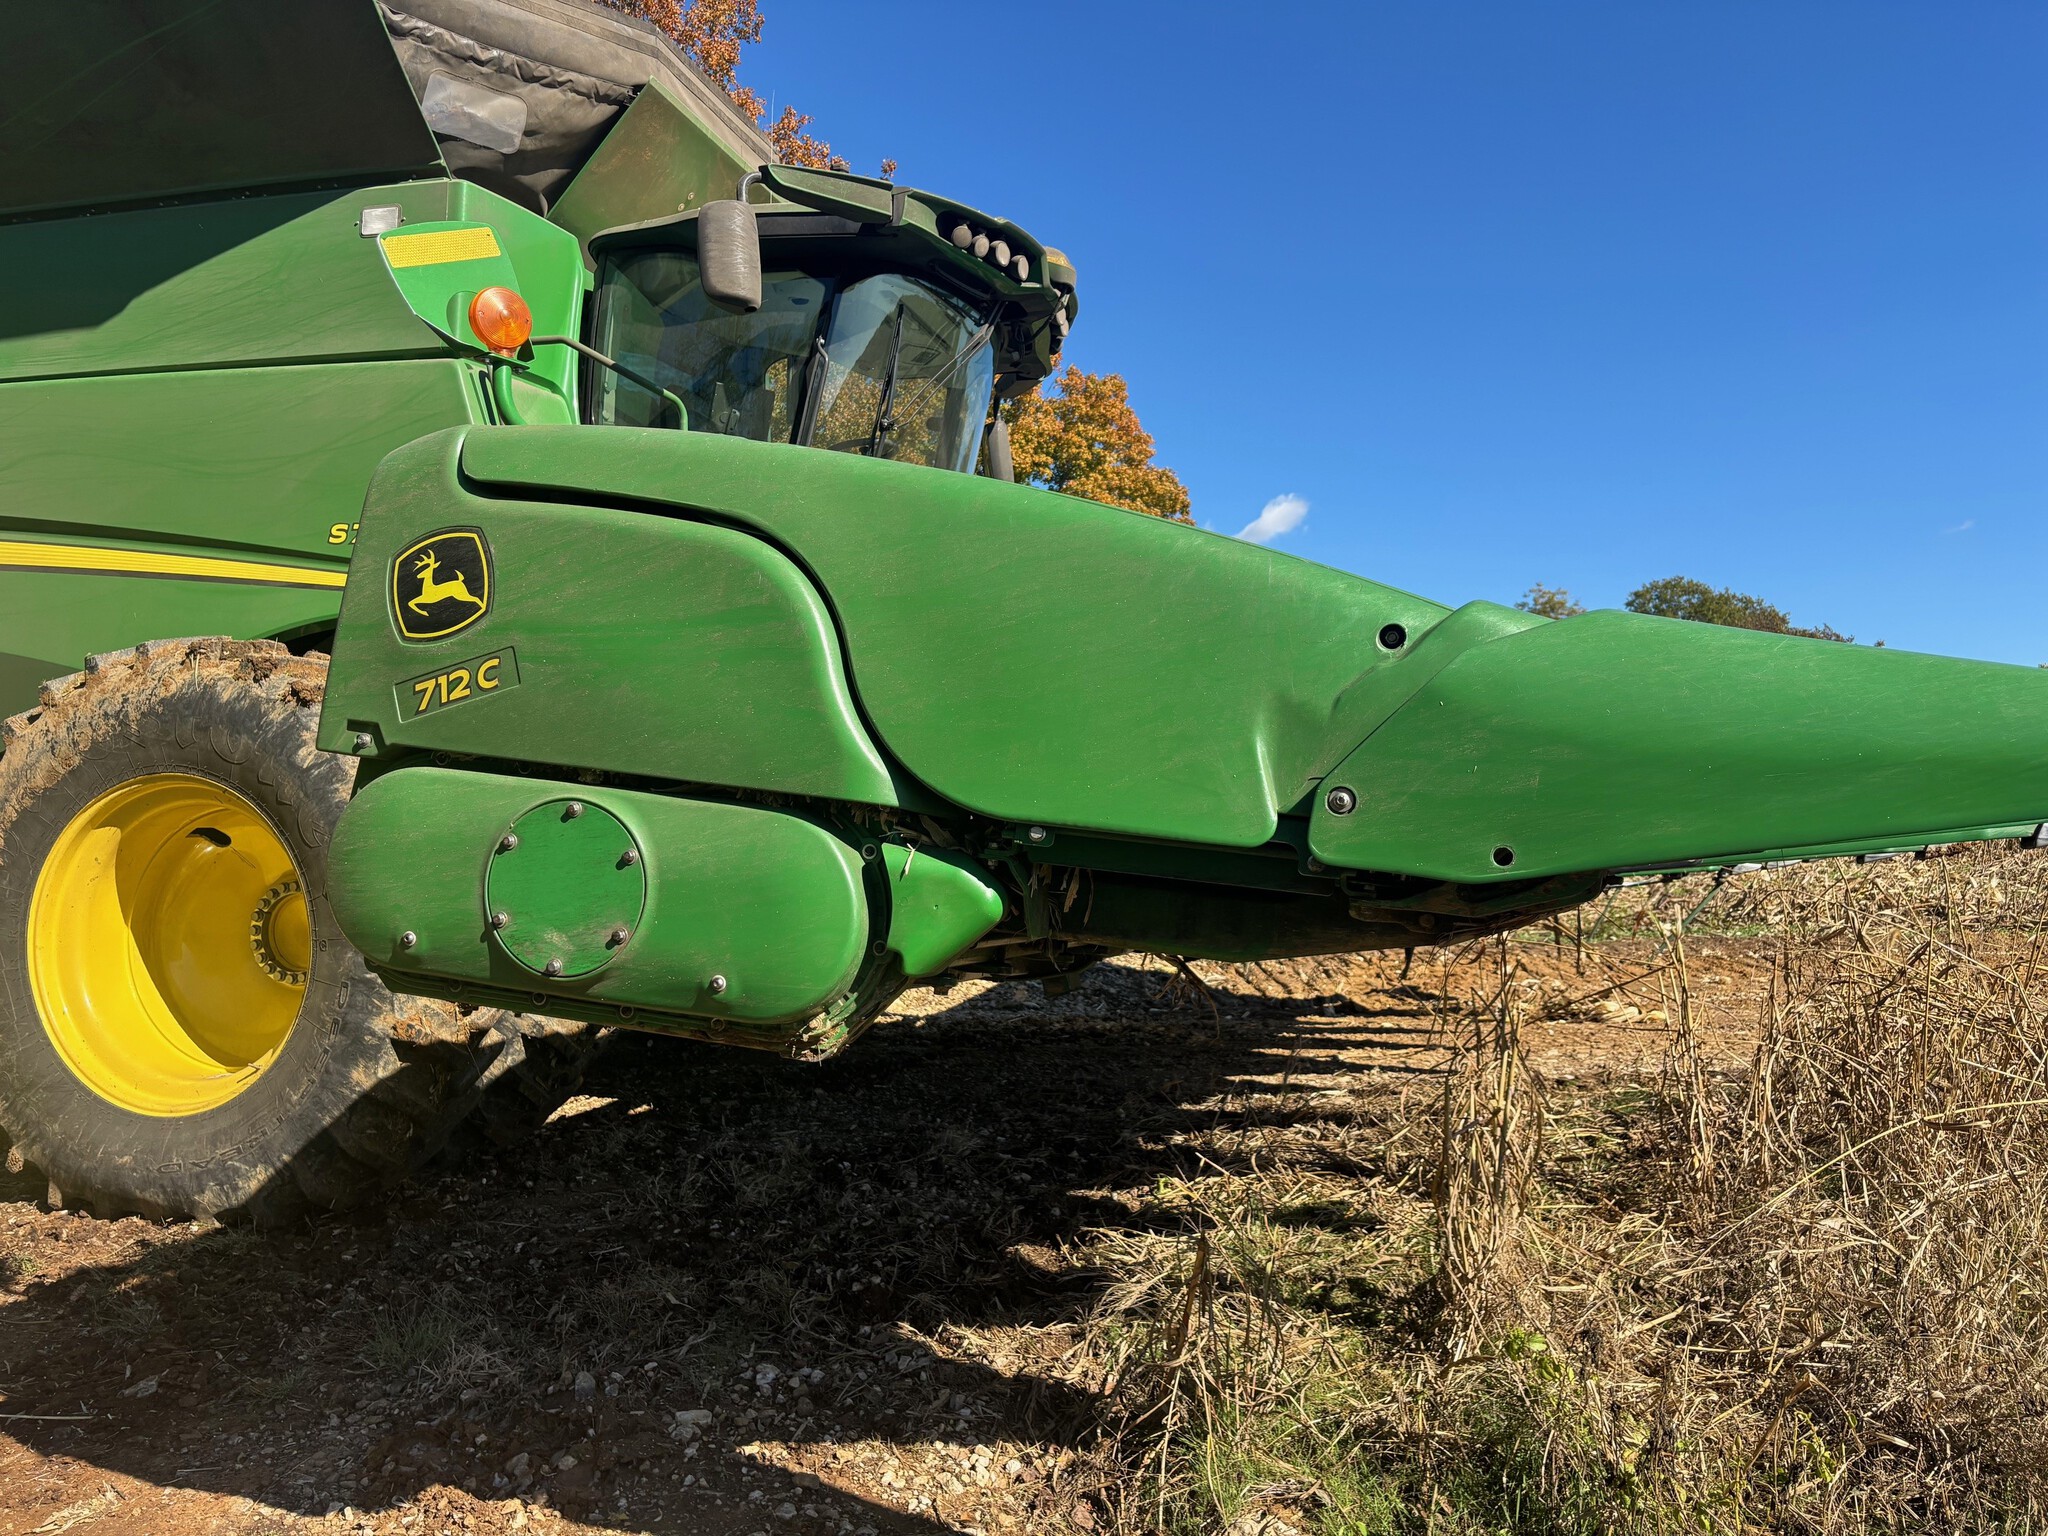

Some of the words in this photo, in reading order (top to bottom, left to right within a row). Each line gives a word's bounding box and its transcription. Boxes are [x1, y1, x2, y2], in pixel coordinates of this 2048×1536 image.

[414, 667, 472, 715] 712
[476, 656, 502, 692] C
[299, 980, 350, 1101] DEEP
